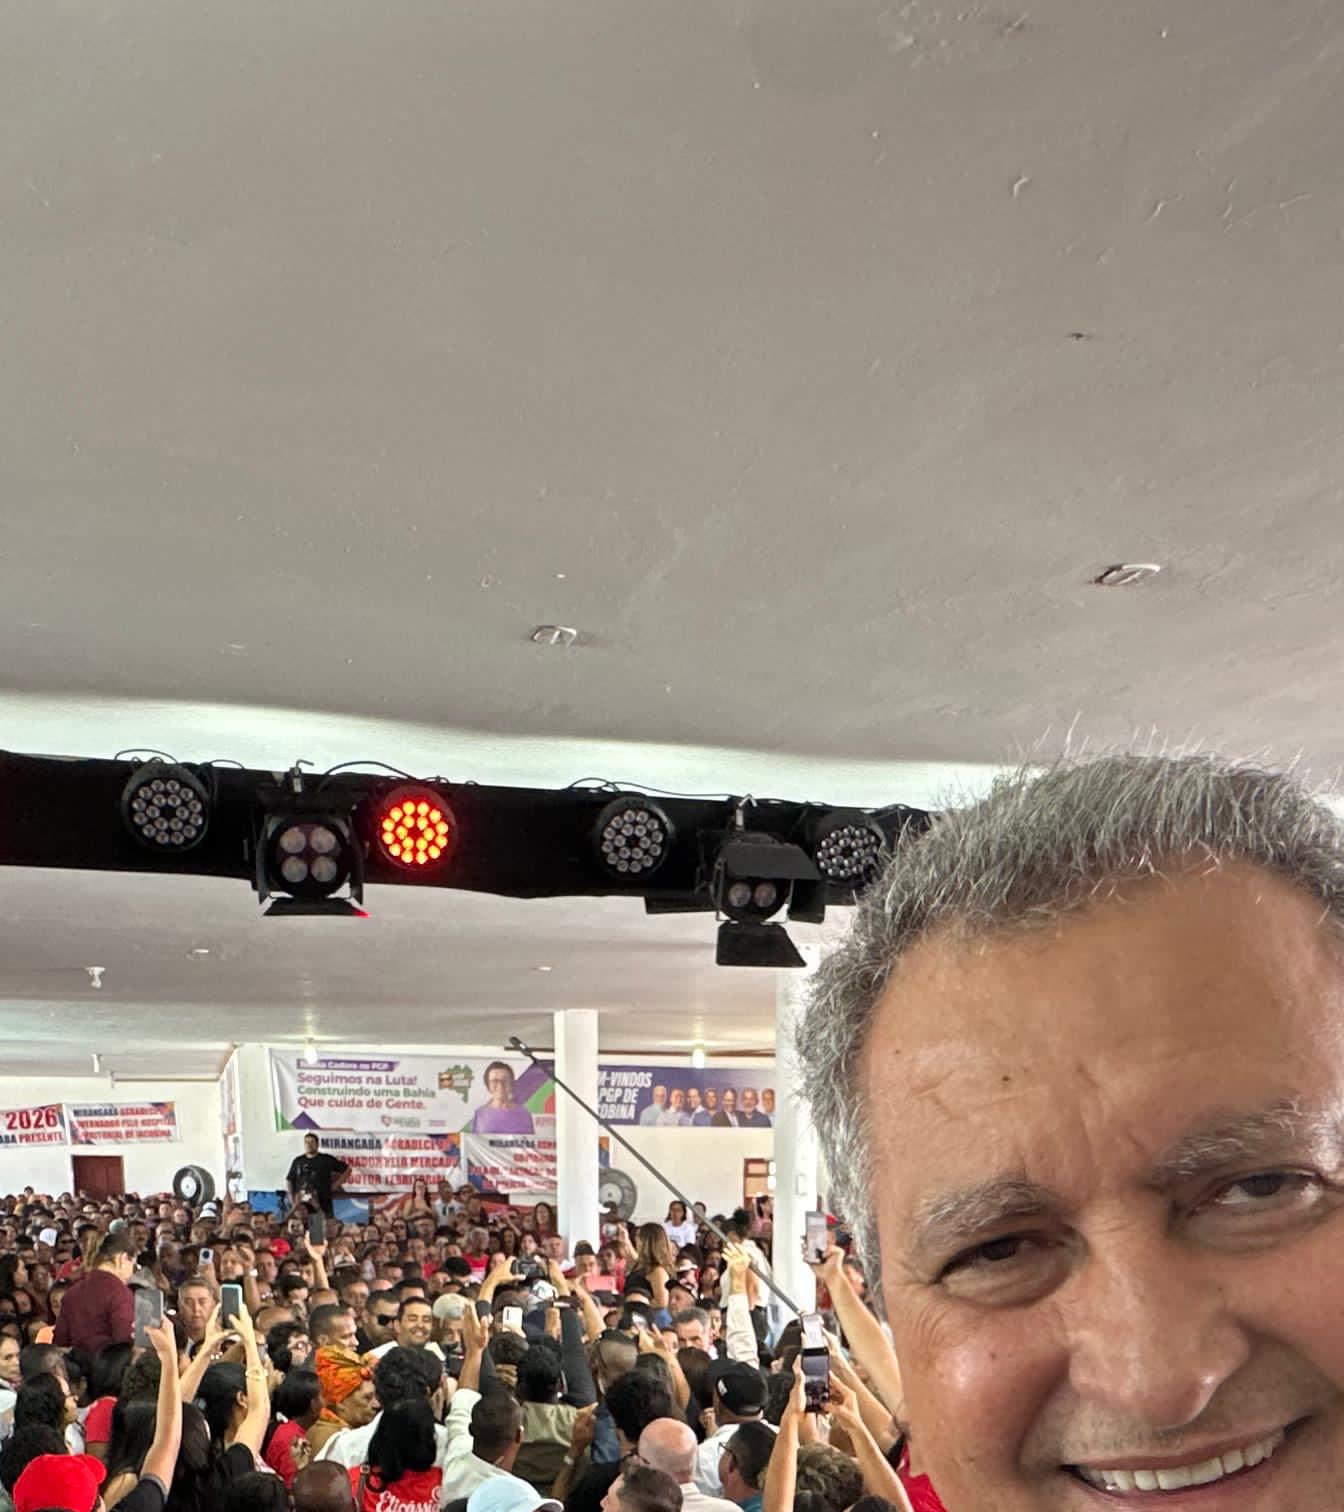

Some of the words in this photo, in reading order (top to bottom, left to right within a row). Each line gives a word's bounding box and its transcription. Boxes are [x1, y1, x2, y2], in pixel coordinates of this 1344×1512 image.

[297, 1072, 363, 1086] Seguimos
[366, 1076, 382, 1084] na
[385, 1074, 418, 1086] Luta!
[297, 1085, 373, 1097] Construindo
[373, 1088, 401, 1097] uma
[402, 1086, 437, 1098] Bahia
[624, 1087, 640, 1104] DE
[297, 1096, 324, 1109] Que
[327, 1097, 363, 1108] cuida
[366, 1098, 383, 1108] de
[385, 1098, 427, 1110] Gente.
[5, 1106, 58, 1130] 2026
[320, 1137, 383, 1150] MIRANGABA
